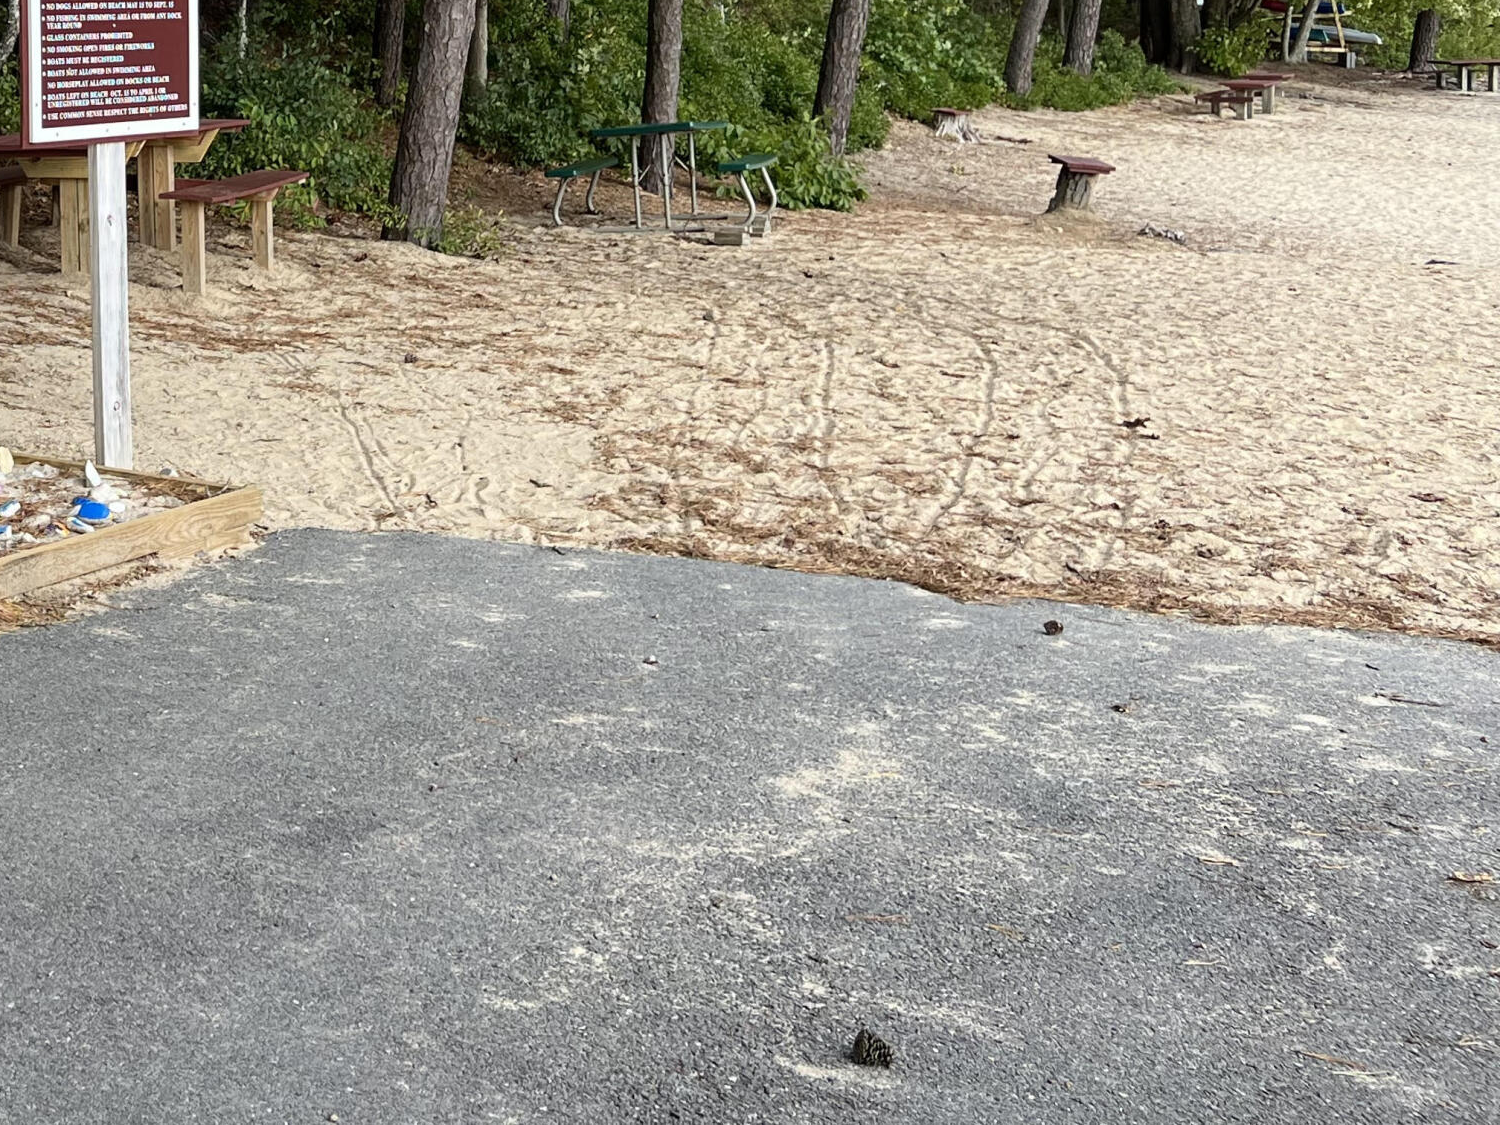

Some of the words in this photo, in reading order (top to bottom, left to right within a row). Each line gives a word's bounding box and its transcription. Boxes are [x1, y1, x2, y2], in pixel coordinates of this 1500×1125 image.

[46, 2, 55, 10] NO
[56, 2, 71, 10] DOGS
[72, 2, 99, 10] ALLOWED
[126, 1, 139, 9] MAY
[145, 1, 153, 9] TO
[168, 1, 175, 9] 15
[46, 14, 55, 22] NO
[87, 13, 117, 21] SWIMMING
[117, 13, 131, 21] AREA
[140, 12, 156, 20] FROM
[156, 12, 167, 20] ANY
[46, 22, 62, 30] YEAR
[46, 33, 65, 41] GLASS
[65, 33, 100, 41] CONTAINERS
[100, 32, 134, 40] PROHIBITED
[46, 45, 55, 53] NO
[56, 45, 82, 53] SMOKING
[99, 44, 115, 52] FIRES
[115, 43, 123, 51] OR
[47, 57, 65, 65] BOATS
[65, 57, 81, 65] MUST
[82, 56, 90, 64] BE
[90, 55, 124, 63] REGISTERED
[47, 69, 65, 77] BOATS
[65, 68, 78, 76] NOT
[78, 67, 105, 76] ALLOWED
[105, 67, 112, 75] IN
[112, 66, 141, 74] SWIMMING
[141, 65, 156, 73] AREA
[47, 81, 56, 89] NO
[56, 80, 89, 89] HORSEPLAY
[89, 78, 115, 87] ALLOWED
[115, 78, 124, 86] ON
[124, 77, 143, 85] DOCKS
[143, 76, 152, 84] OR
[152, 75, 170, 84] BEACH
[47, 93, 65, 101] BOATS
[65, 92, 80, 100] LEFT
[80, 91, 89, 99] ON
[89, 90, 109, 99] BEACH
[110, 89, 123, 97] OCT.
[130, 88, 138, 96] TO
[138, 88, 154, 96] APRIL
[154, 87, 158, 95] 1
[47, 99, 90, 108] UNREGISTERED
[104, 97, 113, 105] BE
[113, 95, 147, 104] CONSIDERED
[147, 93, 179, 102] ABANDONED
[47, 112, 59, 120] USE
[59, 111, 85, 120] COMMON
[85, 110, 103, 118] SENSE
[103, 108, 127, 117] RESPECT
[128, 107, 139, 115] THE
[139, 106, 159, 114] RIGHTS
[159, 105, 167, 113] OF
[167, 104, 187, 112] OTHERS
